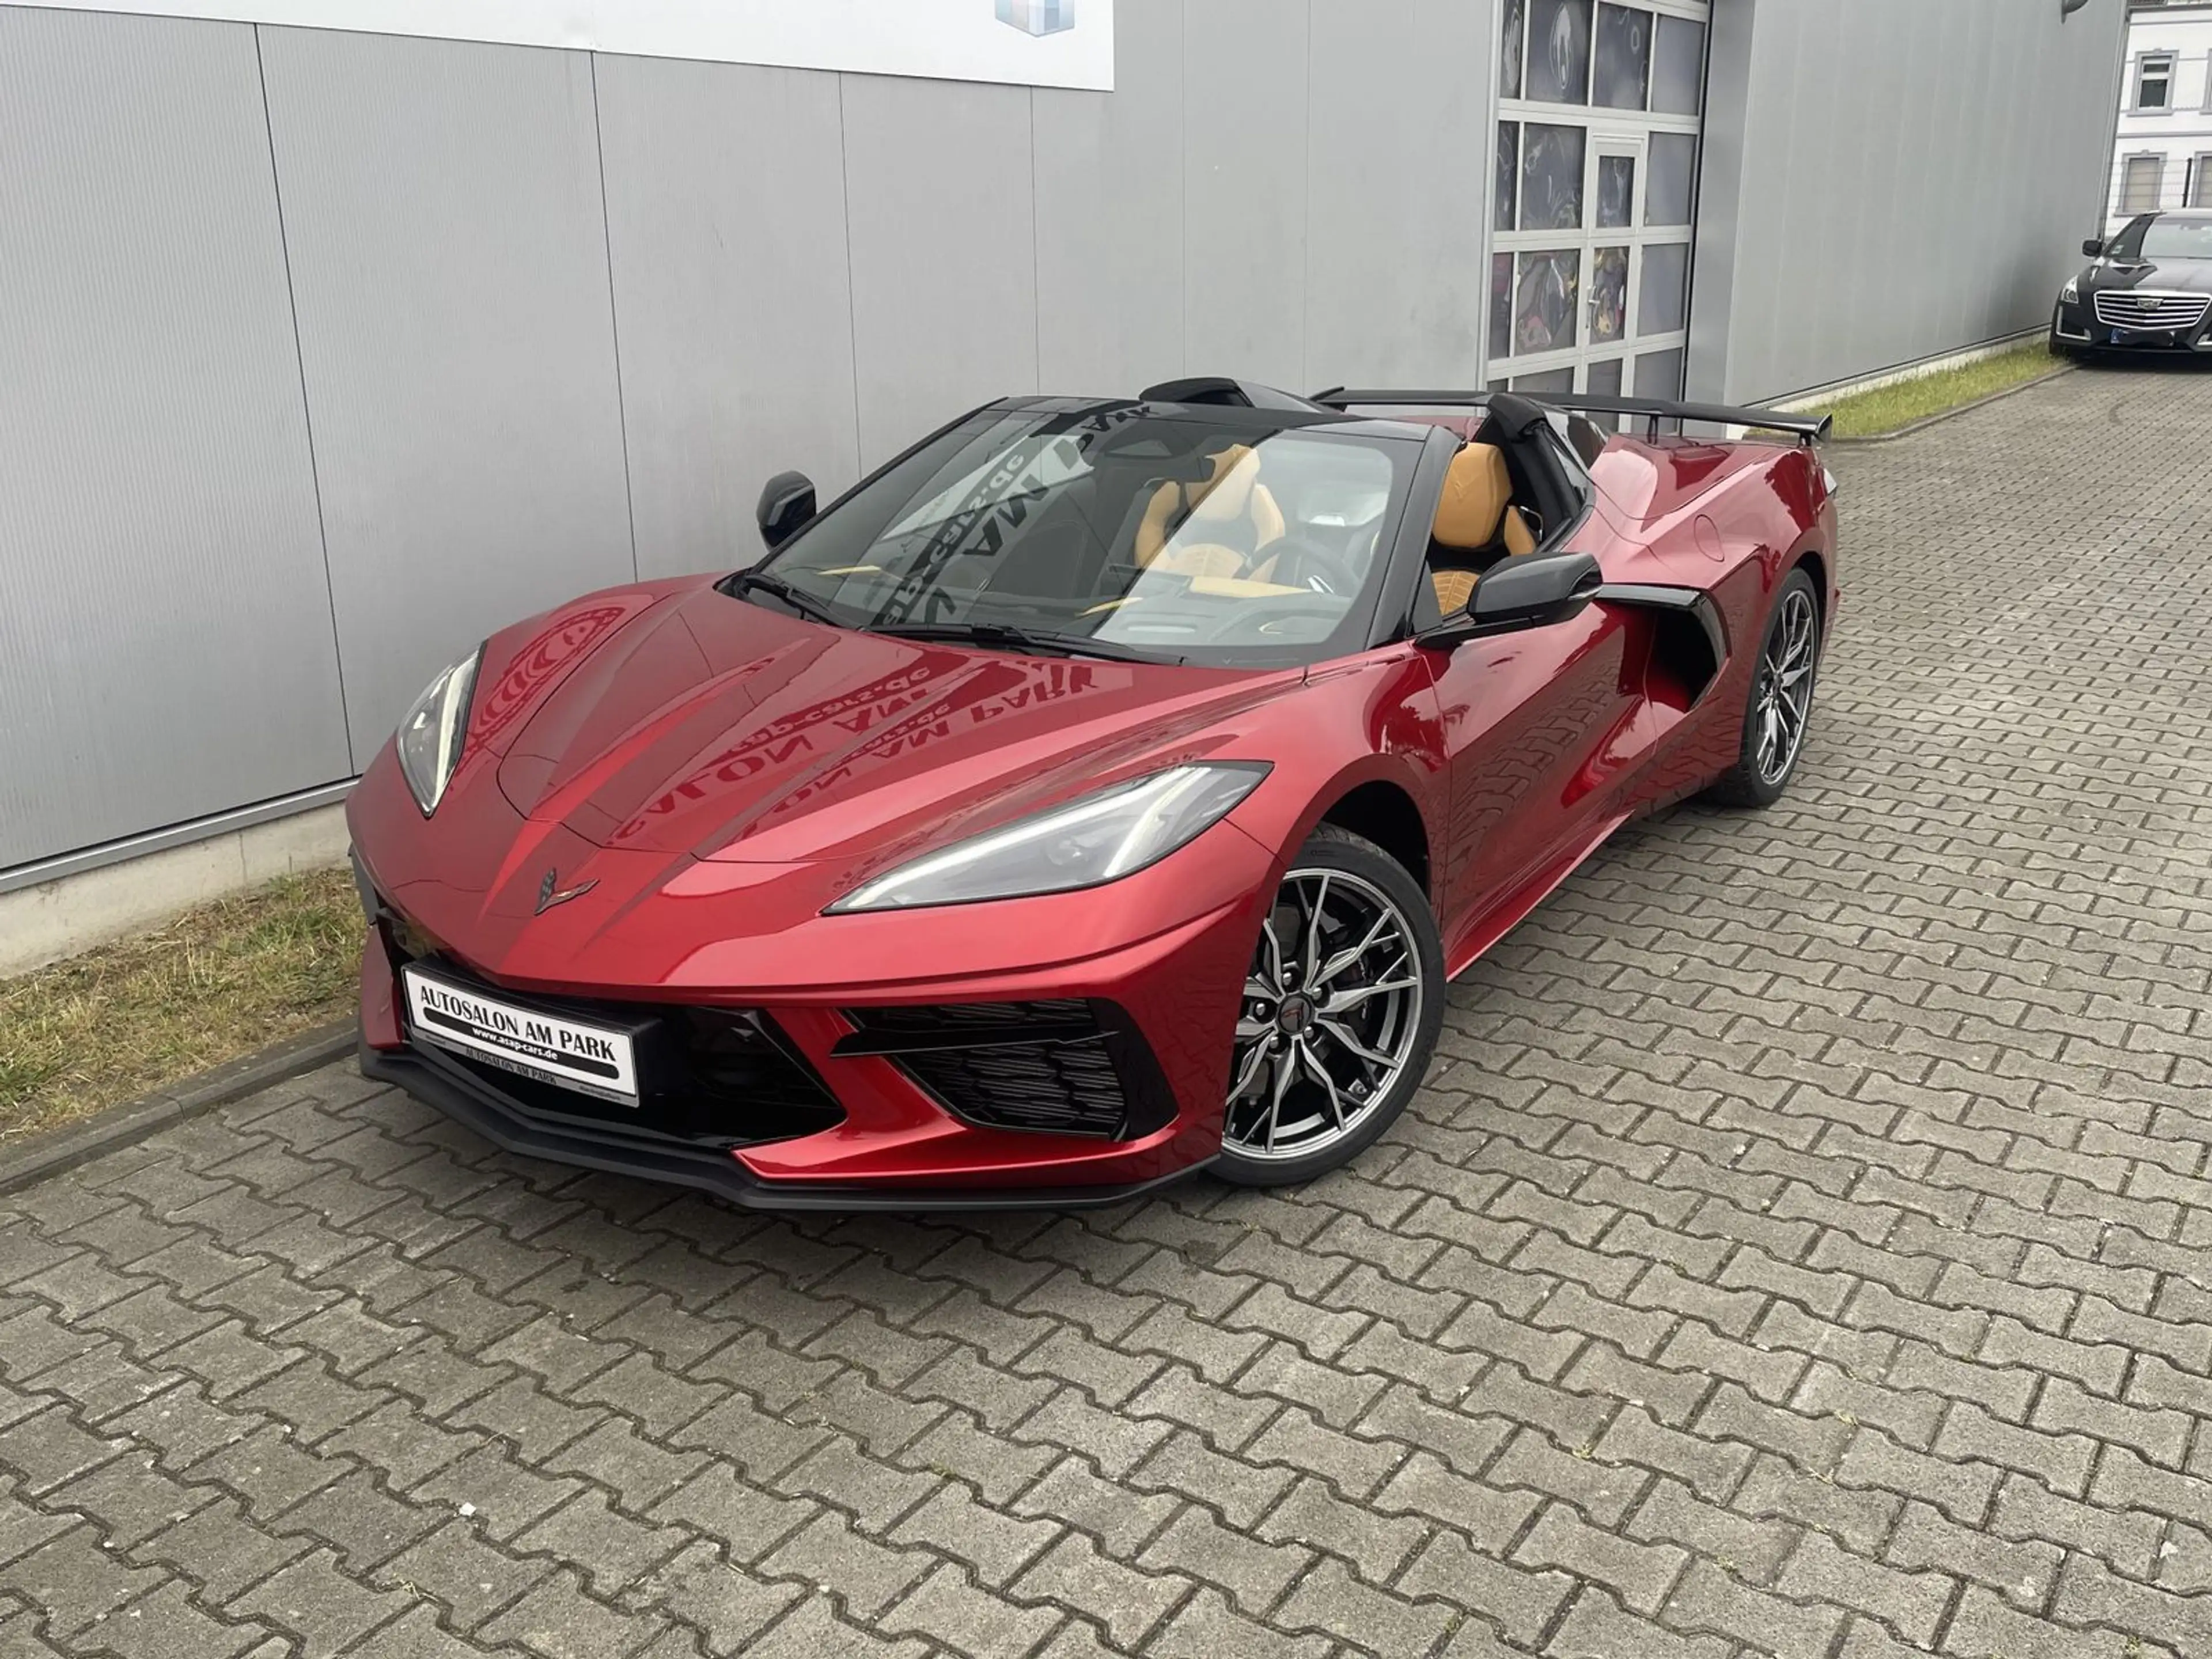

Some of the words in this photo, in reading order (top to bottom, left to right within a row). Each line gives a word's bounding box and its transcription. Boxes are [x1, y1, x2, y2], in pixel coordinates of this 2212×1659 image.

[421, 986, 519, 1035] AUTOSALON
[525, 1021, 554, 1046] AM
[559, 1030, 616, 1062] PARK
[472, 1027, 558, 1060] www.asap-cars.de
